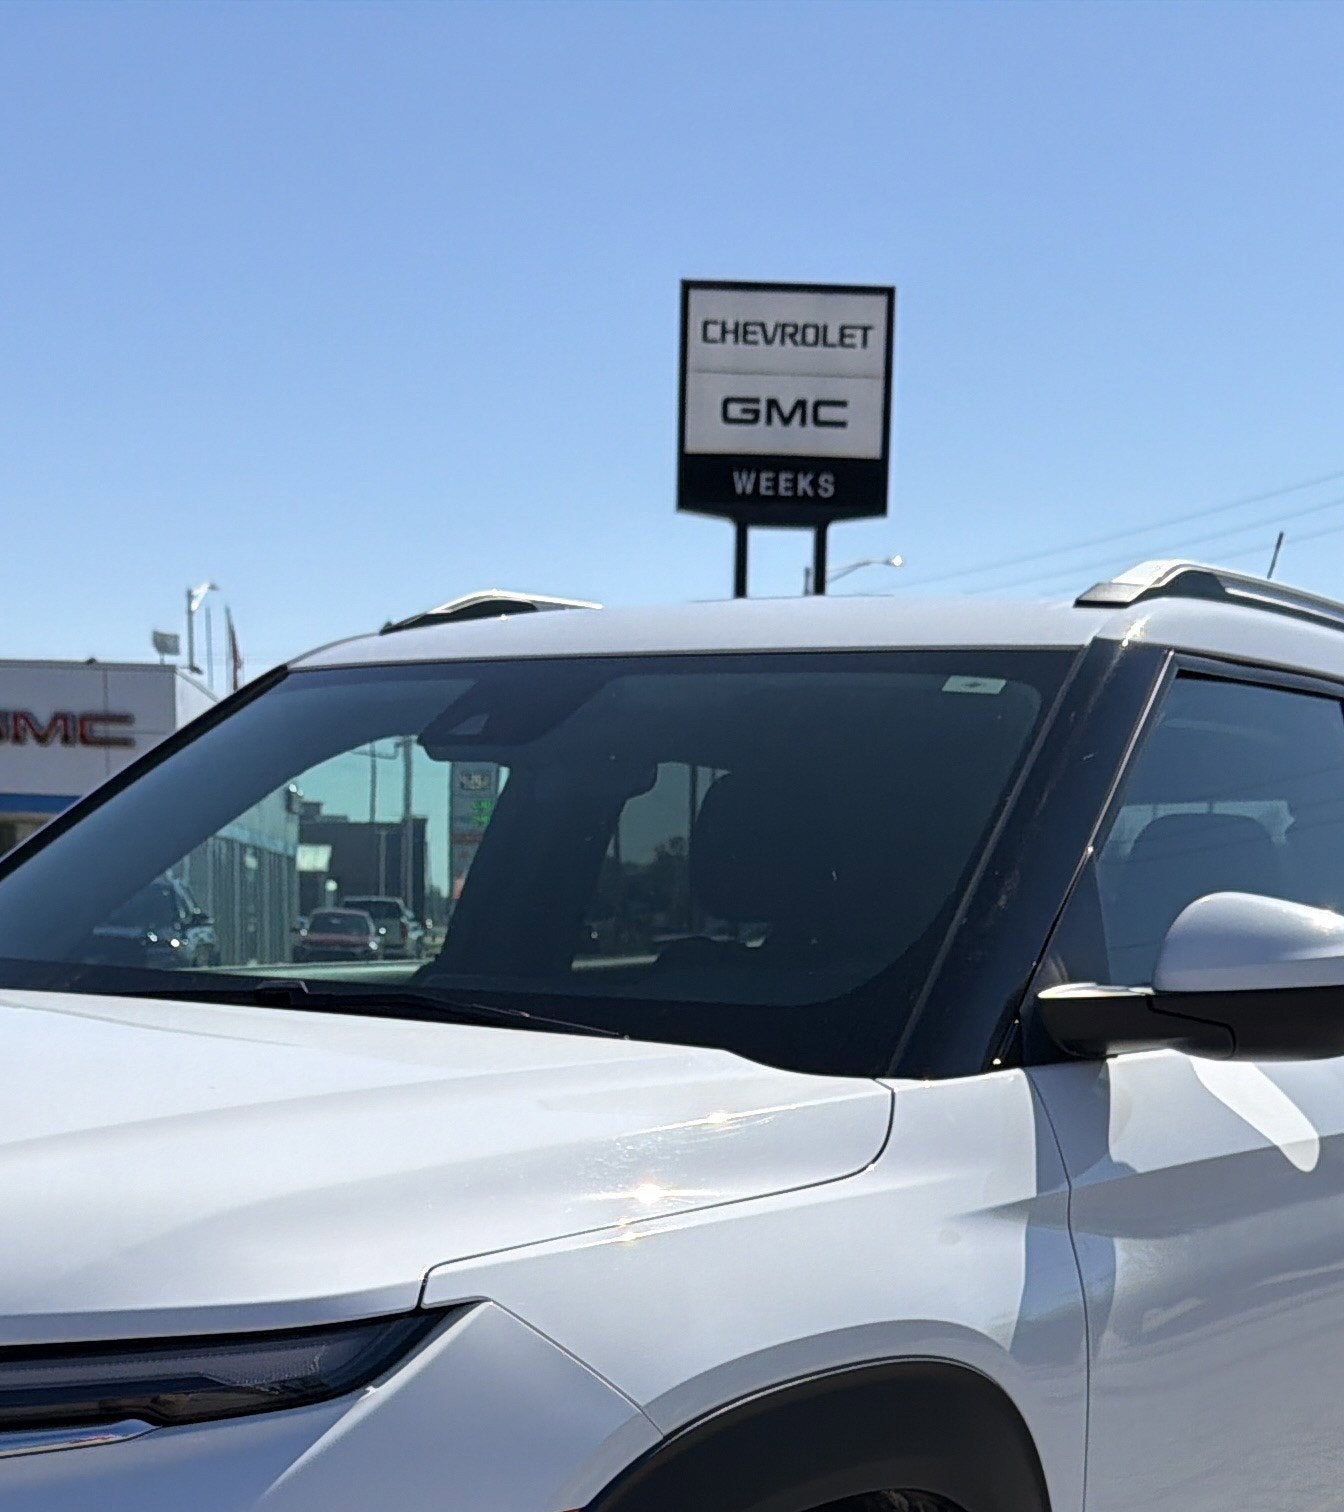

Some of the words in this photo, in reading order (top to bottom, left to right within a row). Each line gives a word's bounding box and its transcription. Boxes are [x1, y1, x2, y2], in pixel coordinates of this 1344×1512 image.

[701, 319, 875, 349] CHEVROLET
[721, 396, 849, 428] GMC
[732, 468, 837, 498] WEEKS
